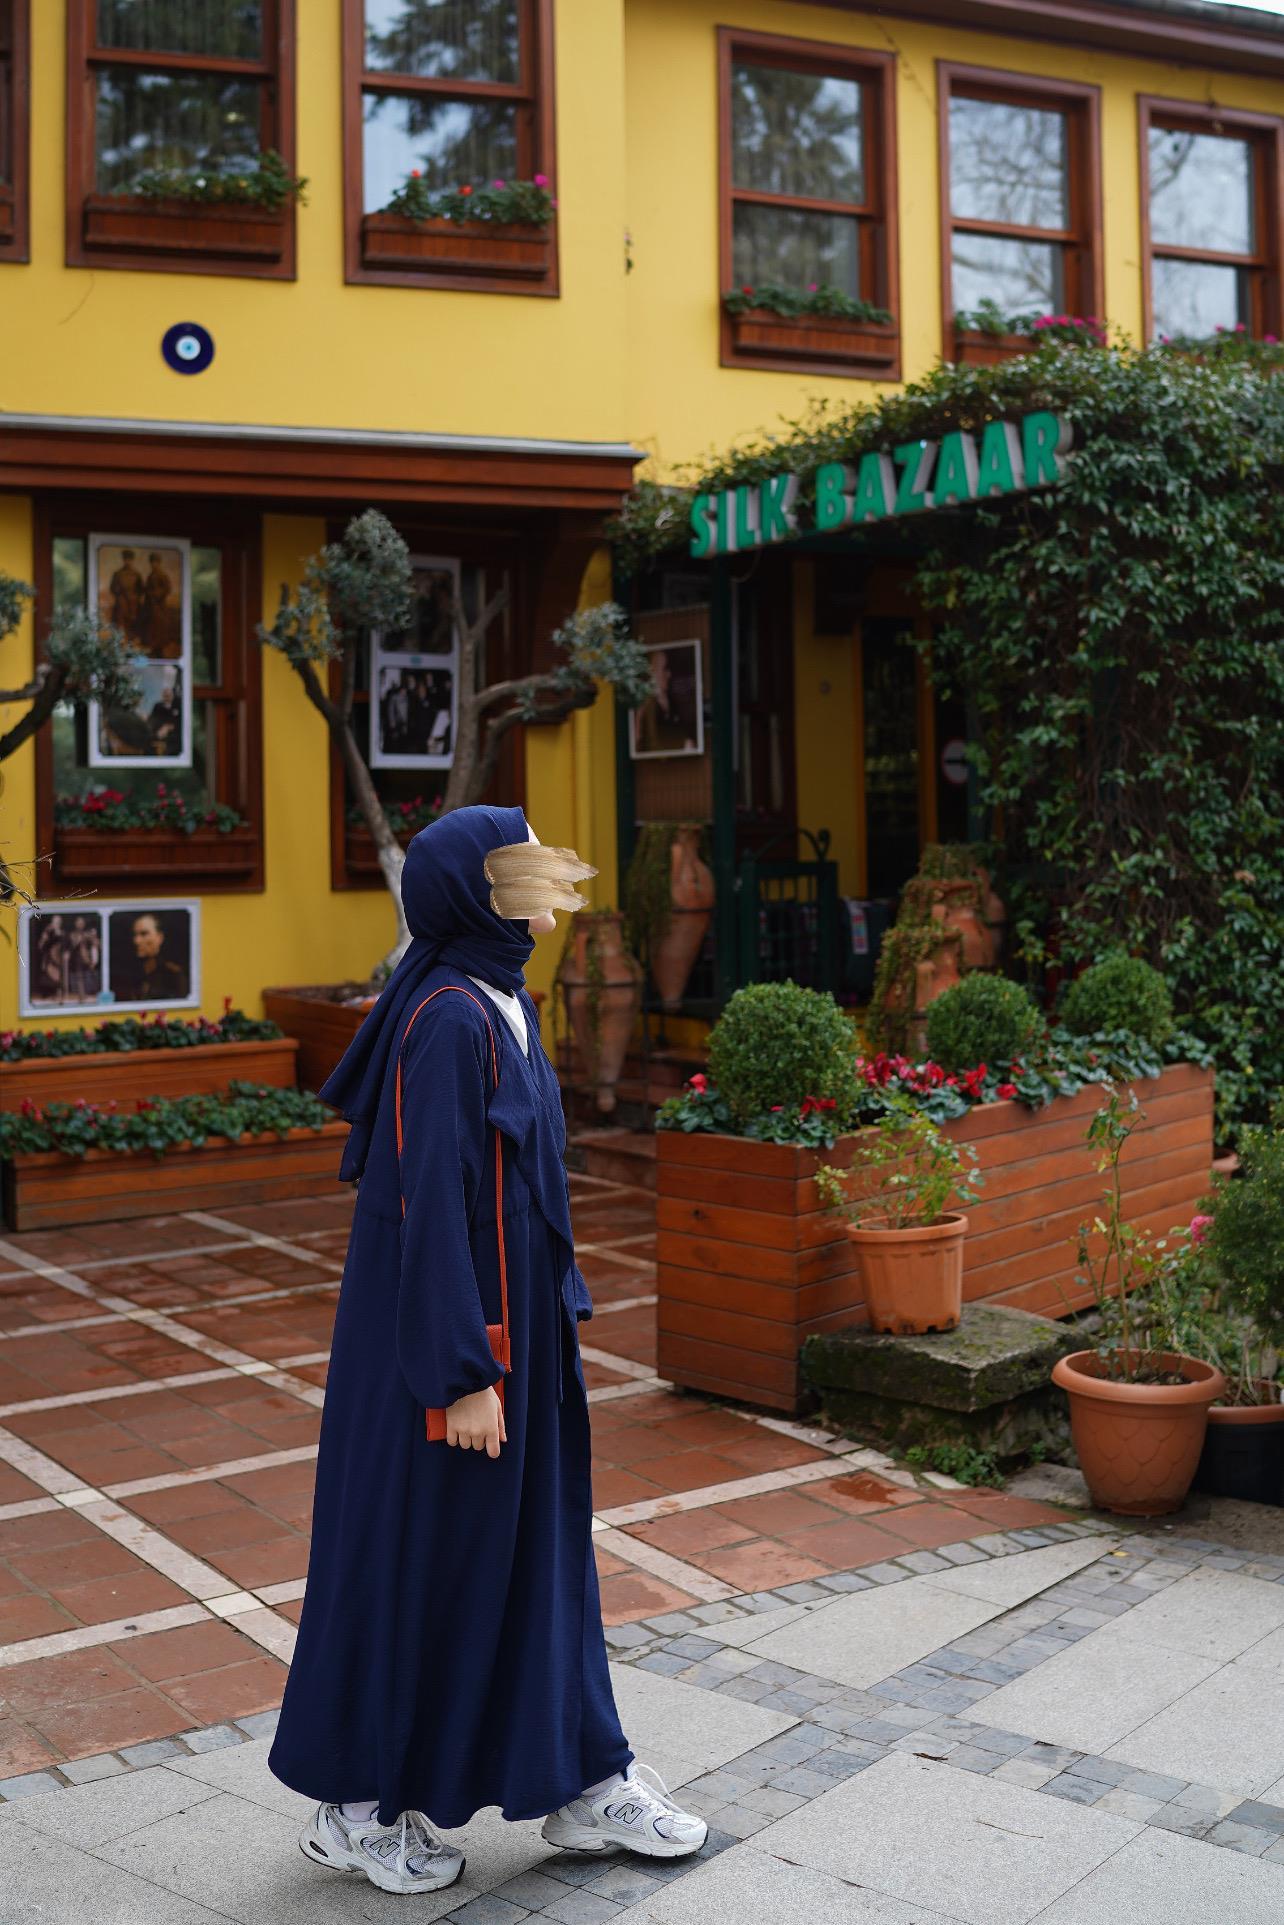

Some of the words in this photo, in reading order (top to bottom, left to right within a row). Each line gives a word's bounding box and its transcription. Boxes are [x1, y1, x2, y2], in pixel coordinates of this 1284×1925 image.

[690, 473, 793, 558] SILK
[816, 410, 1064, 530] BAZAAR
[614, 1802, 643, 1825] N
[369, 1836, 401, 1858] N
